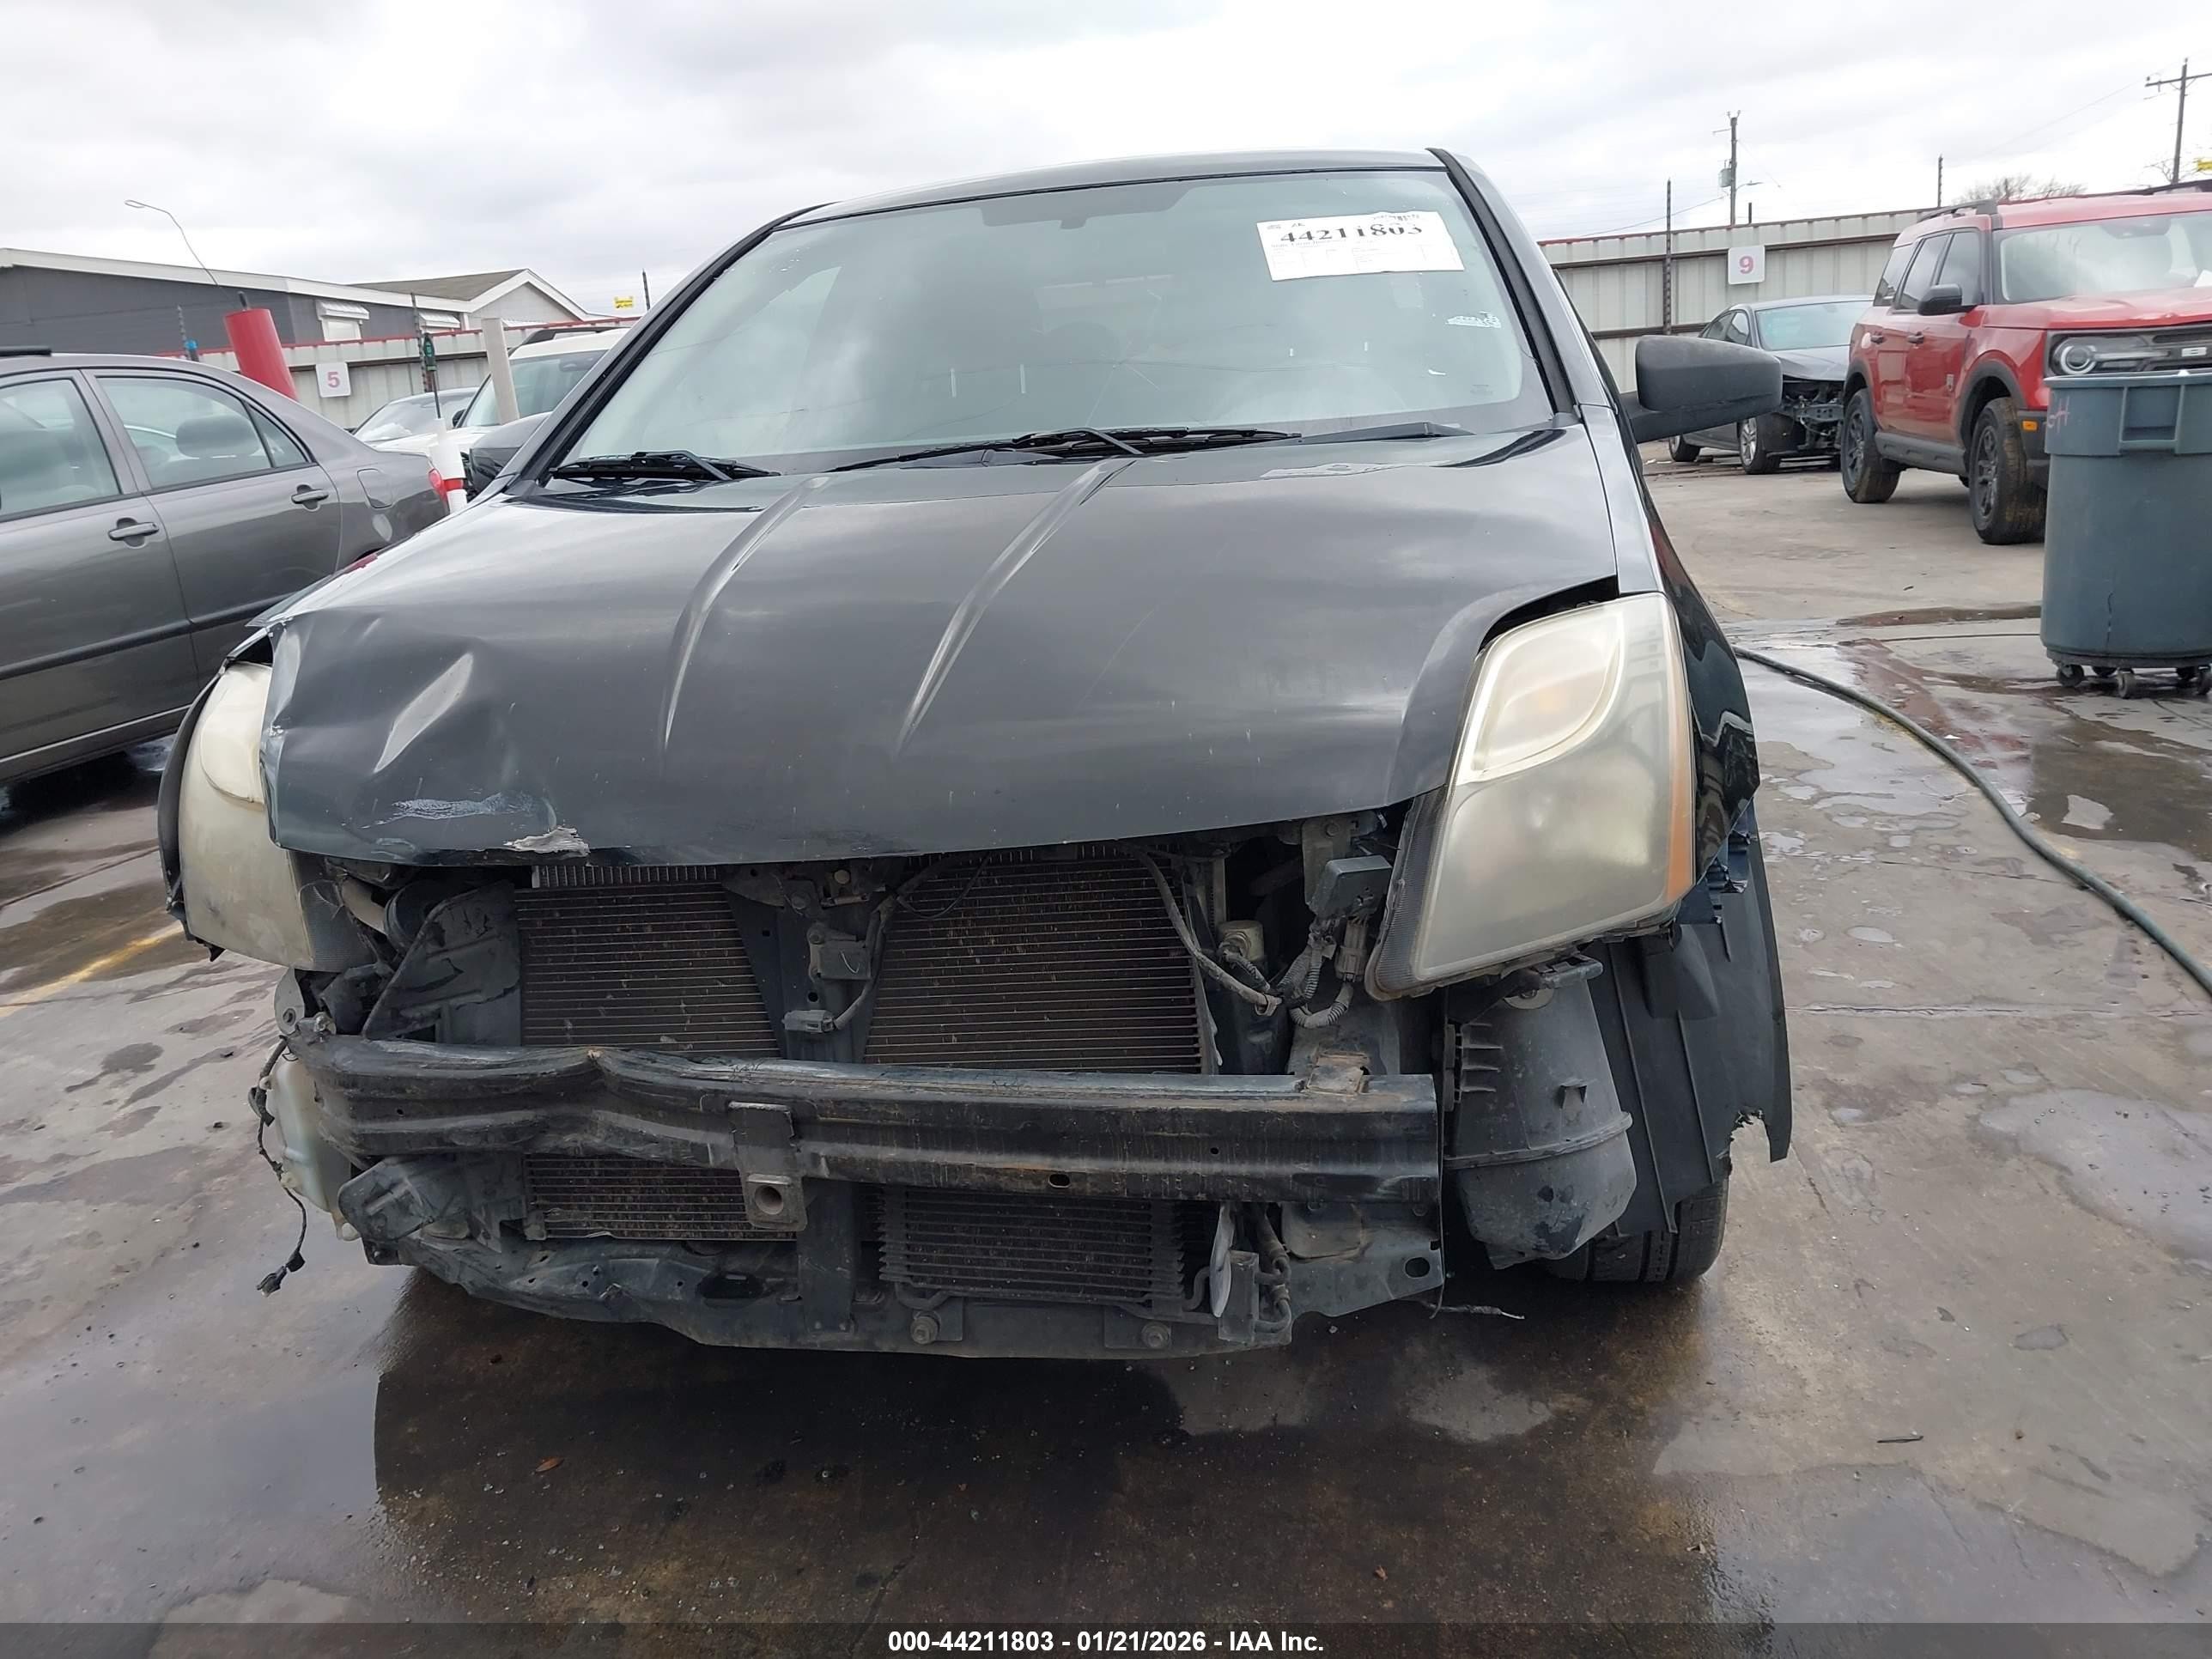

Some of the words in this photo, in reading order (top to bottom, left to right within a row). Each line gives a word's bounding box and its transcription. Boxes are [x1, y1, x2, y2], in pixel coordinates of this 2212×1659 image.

[1280, 222, 1422, 242] 44211803
[1739, 255, 1753, 274] 9
[327, 371, 340, 388] 5
